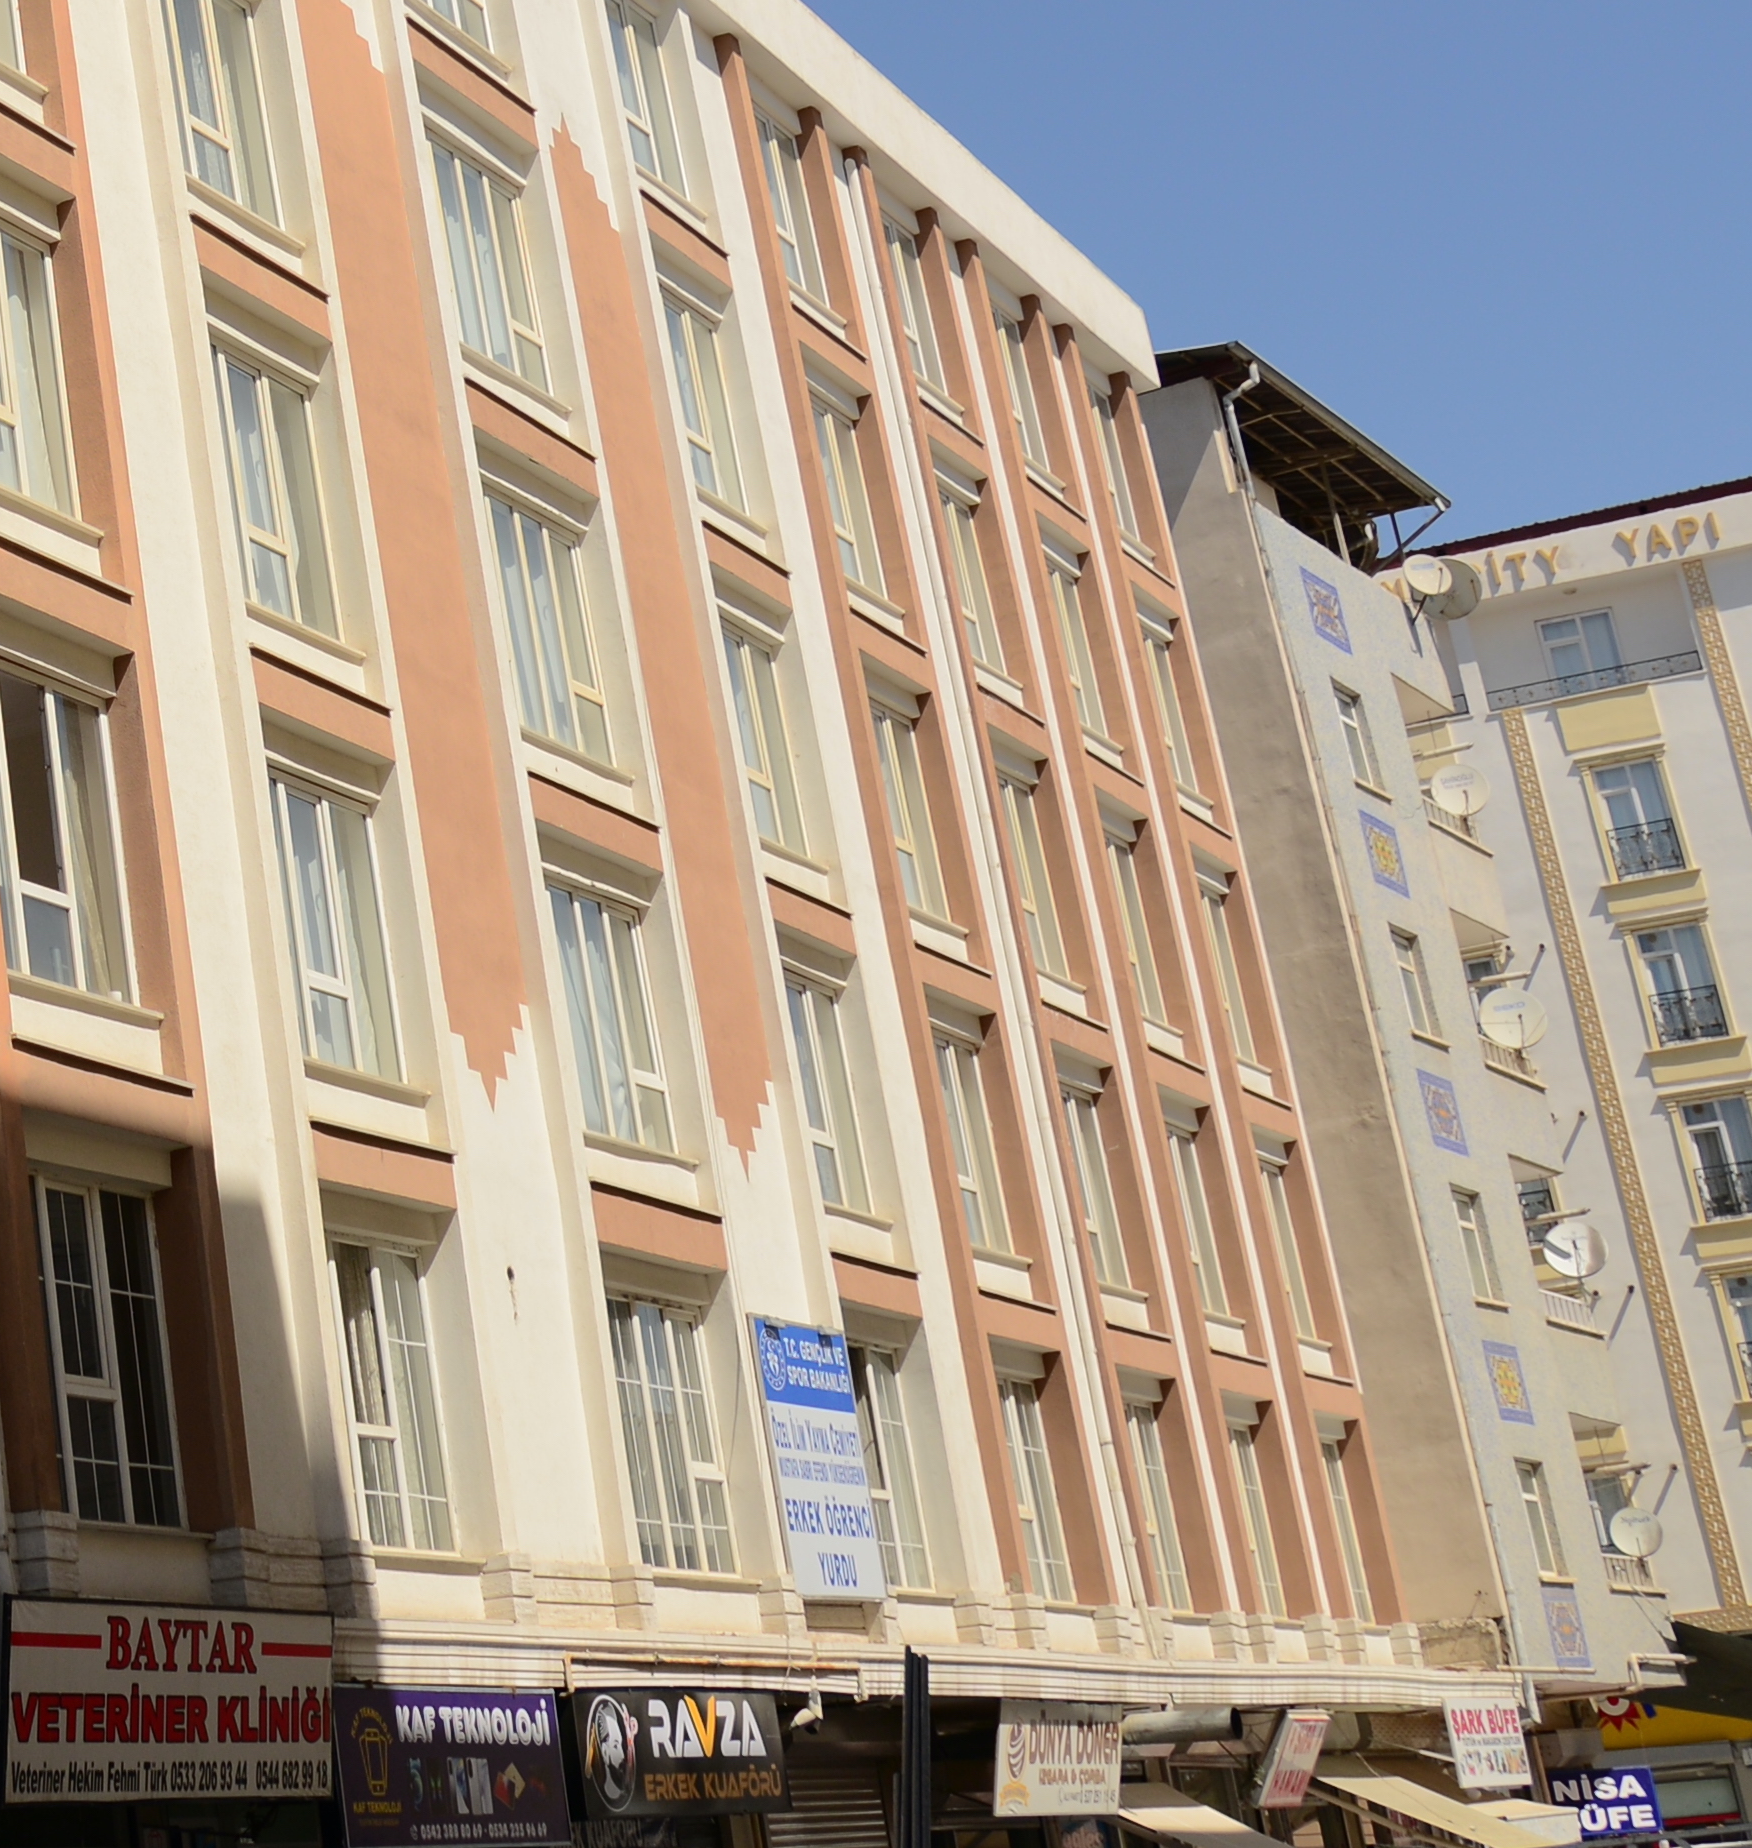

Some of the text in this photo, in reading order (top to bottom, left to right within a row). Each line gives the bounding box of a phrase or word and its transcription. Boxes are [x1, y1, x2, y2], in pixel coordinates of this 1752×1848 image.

[1616, 512, 1720, 557] YAPI
[832, 1347, 846, 1367] VE
[787, 1365, 810, 1388] SPOR
[785, 1495, 874, 1538] ERKEK ÖĞRENCİ
[817, 1552, 857, 1587] YURDU
[106, 1616, 257, 1674] BAYTAR
[11, 1683, 330, 1743] VETERİNER KLİNİĞİ
[395, 1698, 550, 1745] KAF TEKNOLOJİ
[648, 1694, 767, 1758] RAVZA
[1451, 1704, 1520, 1741] ŞARK BÜFE
[1029, 1710, 1119, 1764] DÜNYA DÖNER
[12, 1761, 328, 1794] Veteriner Hekim Fehmi Türk 0533 206 93 44 0544 682 99 18
[644, 1764, 782, 1800] ERKEK KUAFÖRÜ
[1552, 1774, 1647, 1802] NİSA
[354, 1802, 366, 1814] KAF
[1578, 1803, 1657, 1832] ÜFE
